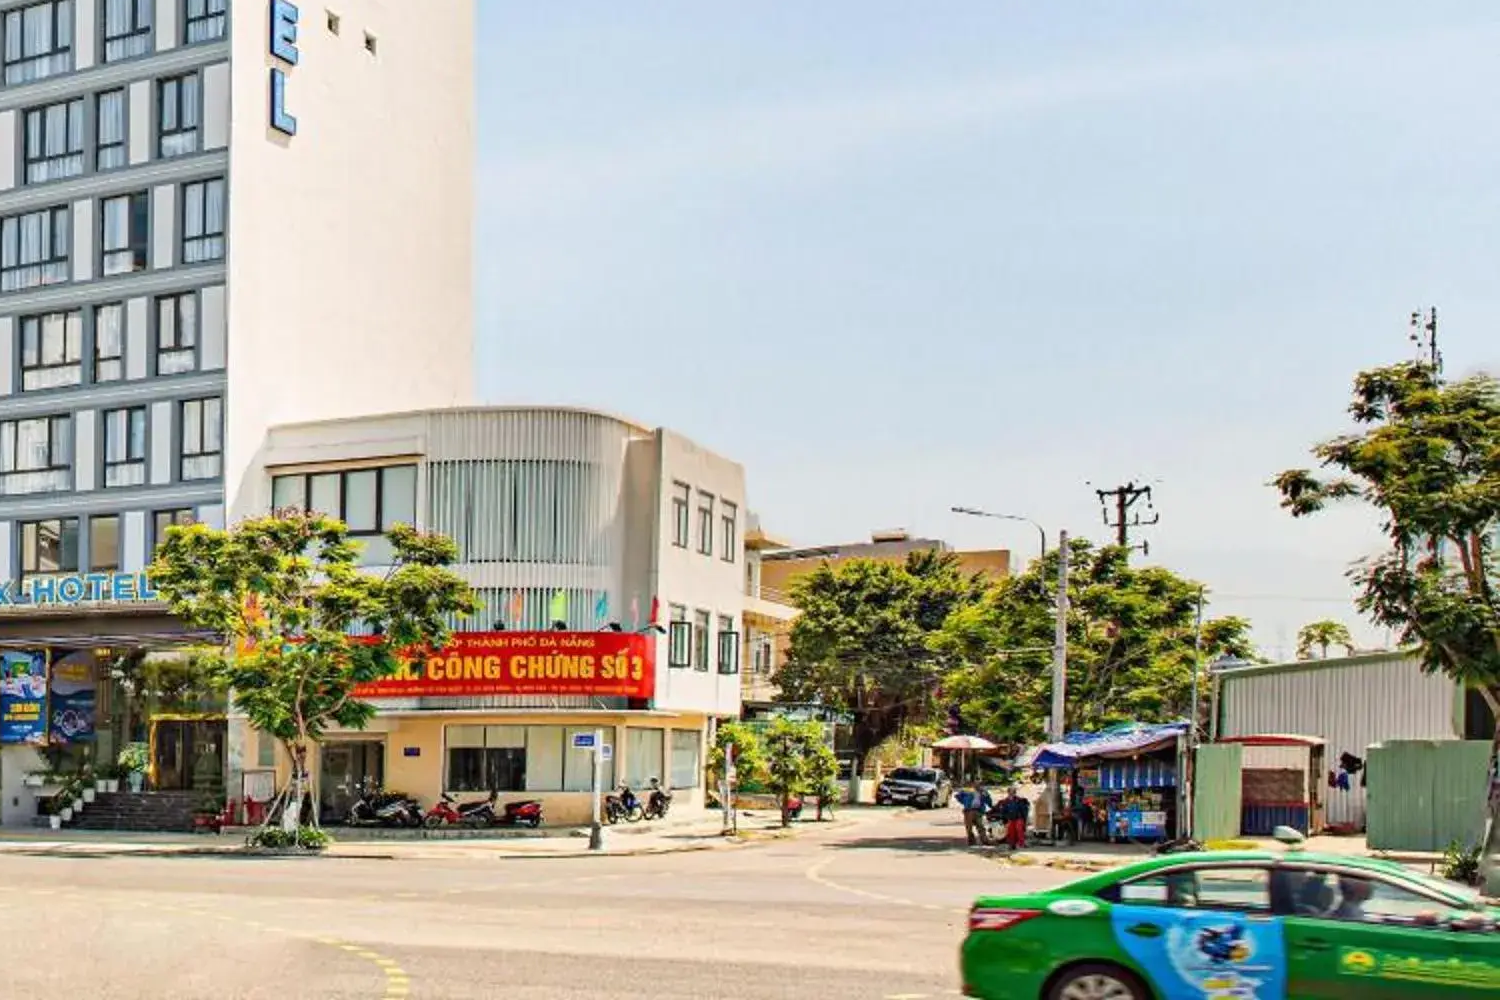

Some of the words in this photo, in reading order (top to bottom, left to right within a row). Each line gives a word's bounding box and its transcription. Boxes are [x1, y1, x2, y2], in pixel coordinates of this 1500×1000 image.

[31, 571, 160, 604] HOTEL
[428, 651, 501, 680] CÔNG
[510, 649, 595, 679] CHỨNG
[601, 648, 629, 679] SỐ
[631, 655, 643, 680] 3
